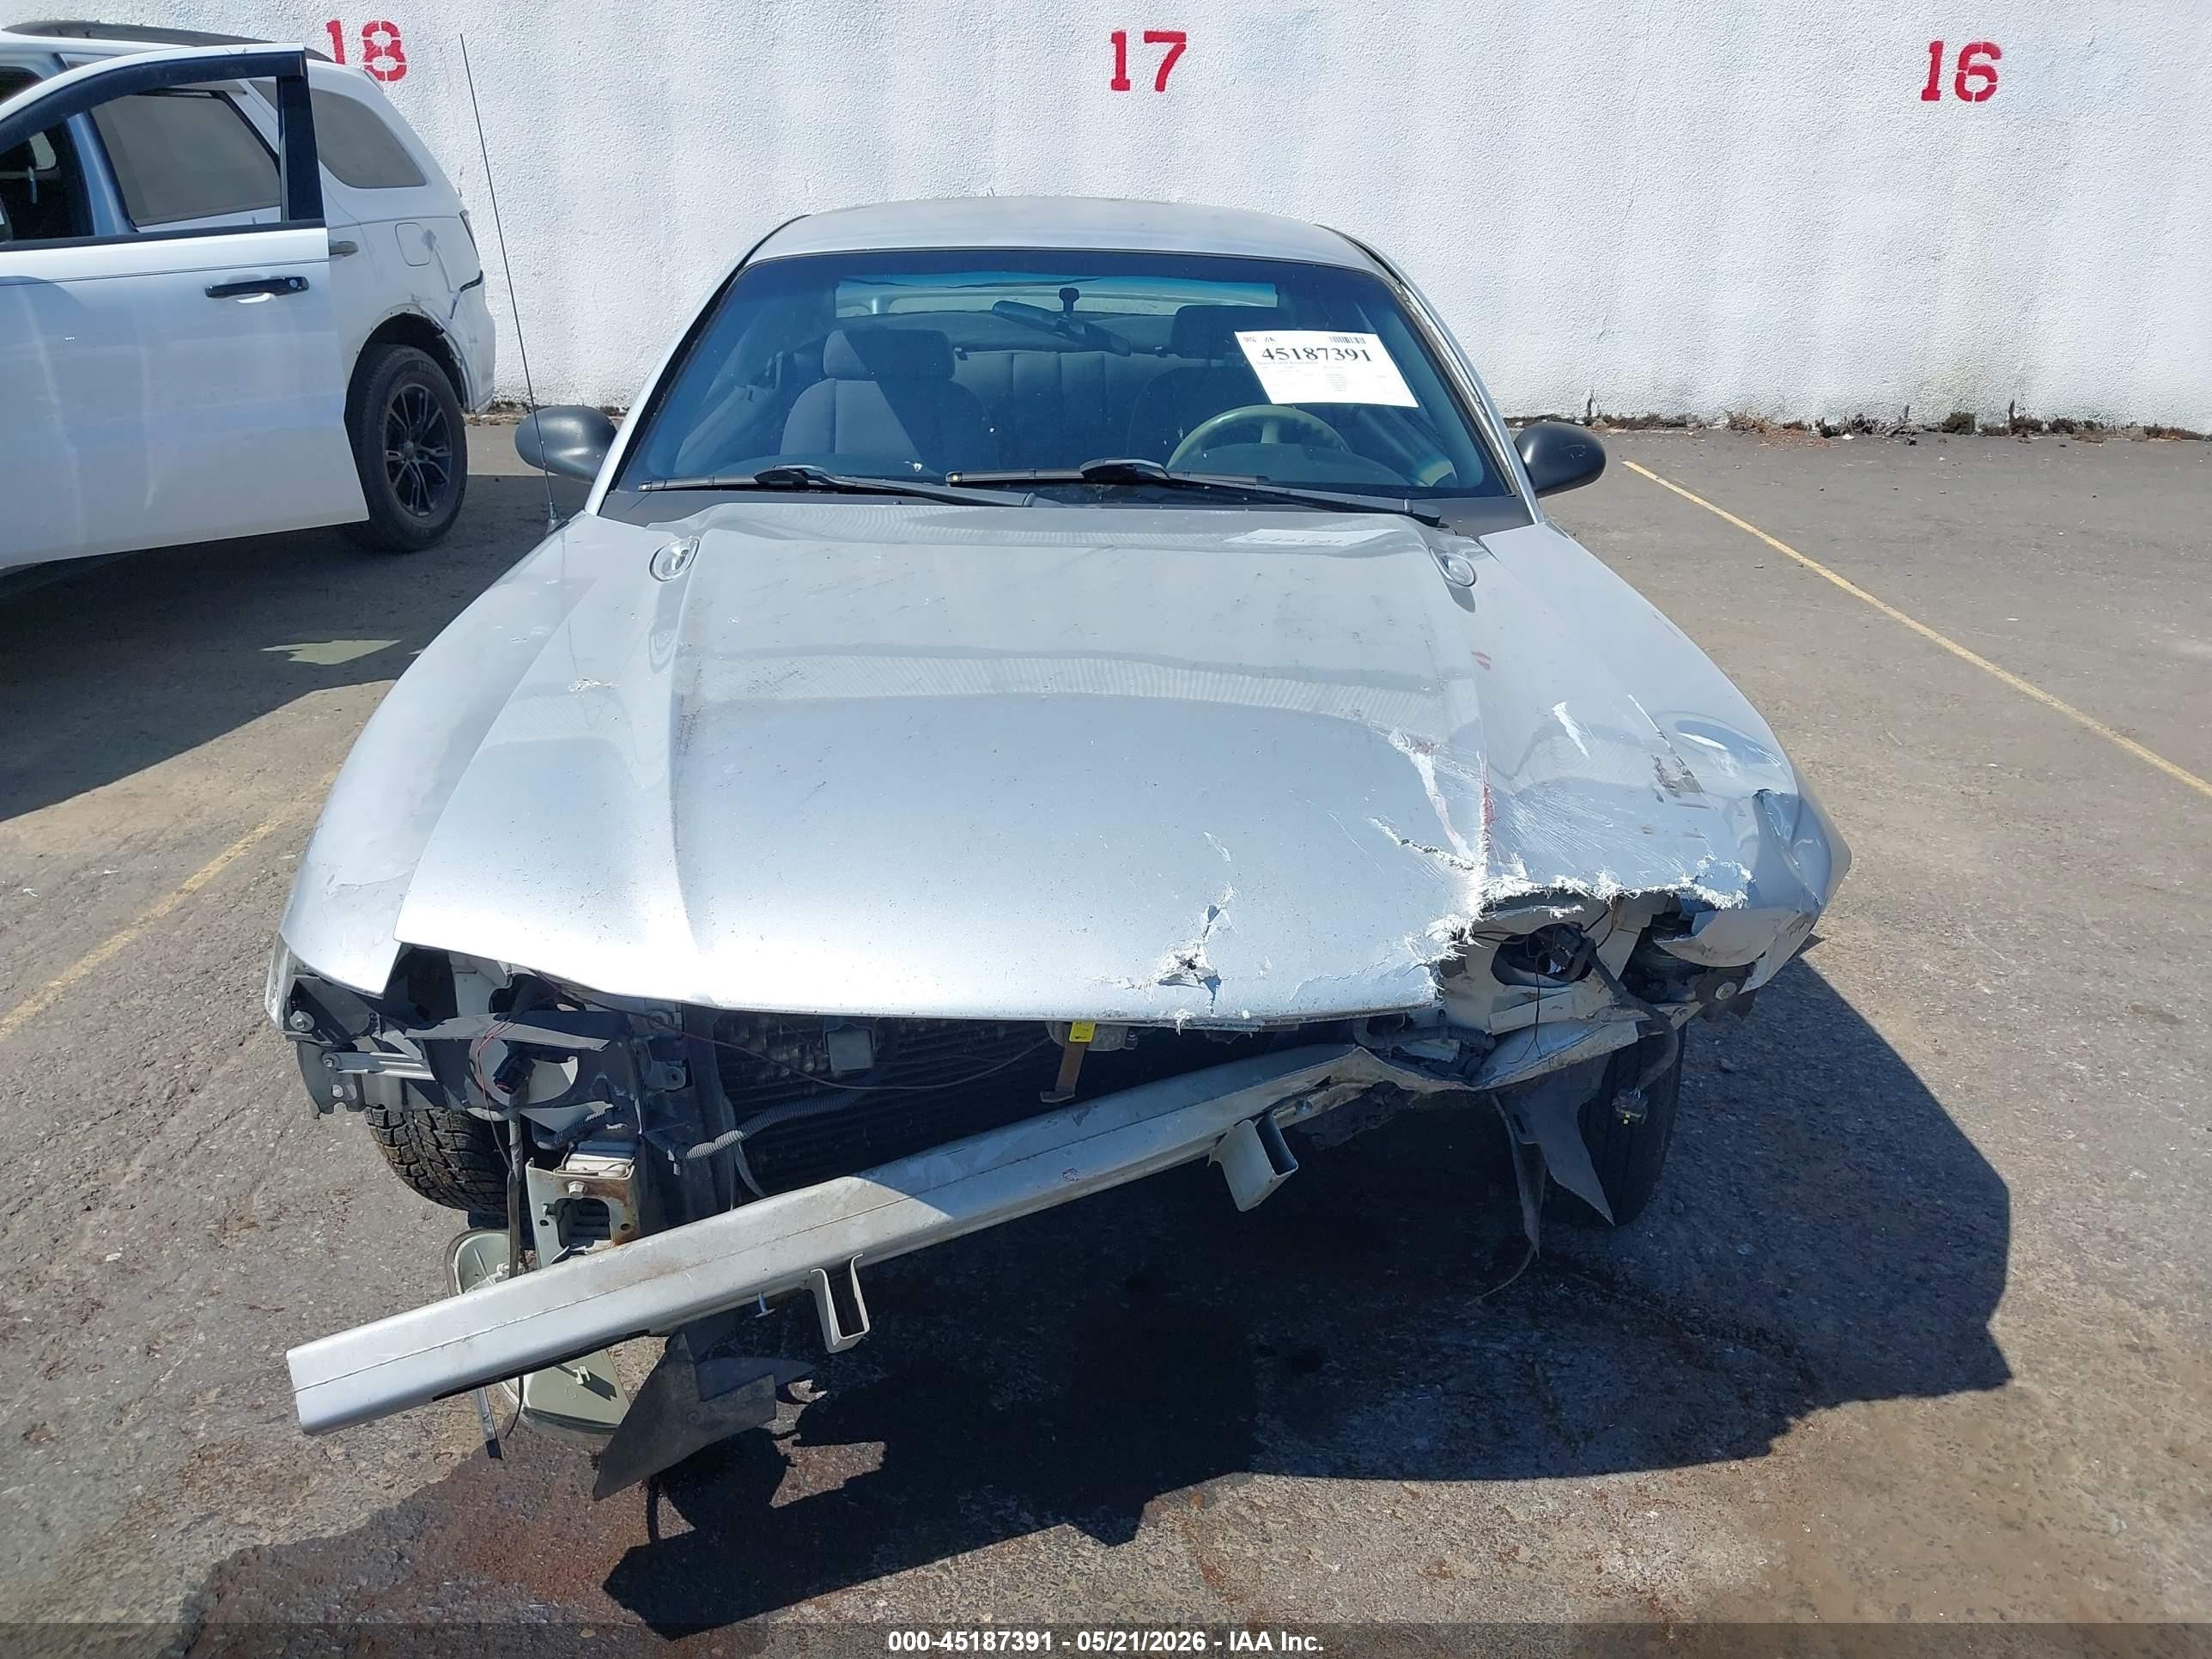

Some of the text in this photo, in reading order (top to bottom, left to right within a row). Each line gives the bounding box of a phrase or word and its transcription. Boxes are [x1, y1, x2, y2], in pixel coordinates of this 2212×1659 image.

[325, 21, 407, 82] 18
[1110, 31, 1187, 92] 17
[1921, 41, 2002, 102] 16
[1261, 347, 1373, 362] 45187391
